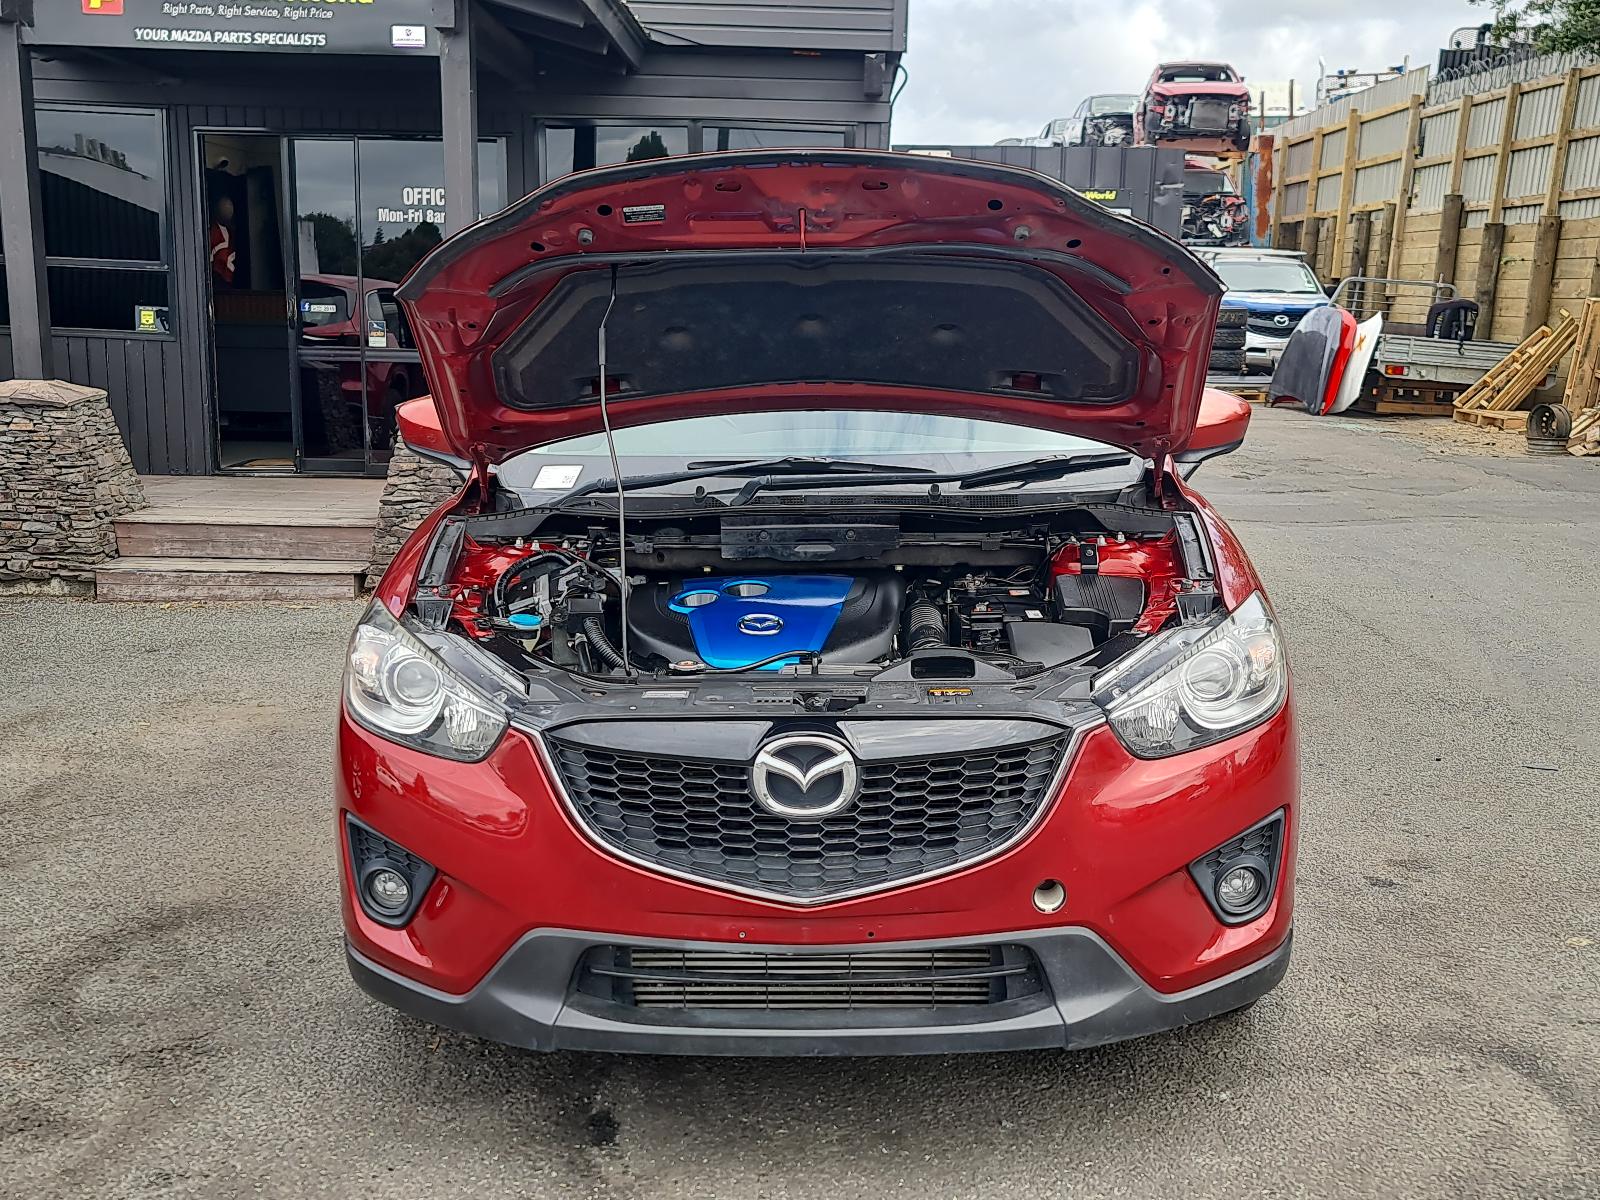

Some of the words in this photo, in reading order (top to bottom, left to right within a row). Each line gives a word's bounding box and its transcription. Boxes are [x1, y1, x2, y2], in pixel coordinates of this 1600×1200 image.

[163, 2, 188, 16] Right
[189, 3, 215, 16] Parts,
[217, 4, 242, 18] Right
[244, 6, 280, 18] Service,
[284, 6, 308, 19] Right
[309, 7, 333, 18] Price
[135, 28, 168, 41] YOUR
[171, 29, 211, 42] MAZDA
[214, 31, 251, 43] PARTS
[253, 32, 326, 45] SPECIALISTS
[403, 187, 445, 206] OFFIC
[378, 208, 423, 223] Mon-Fri
